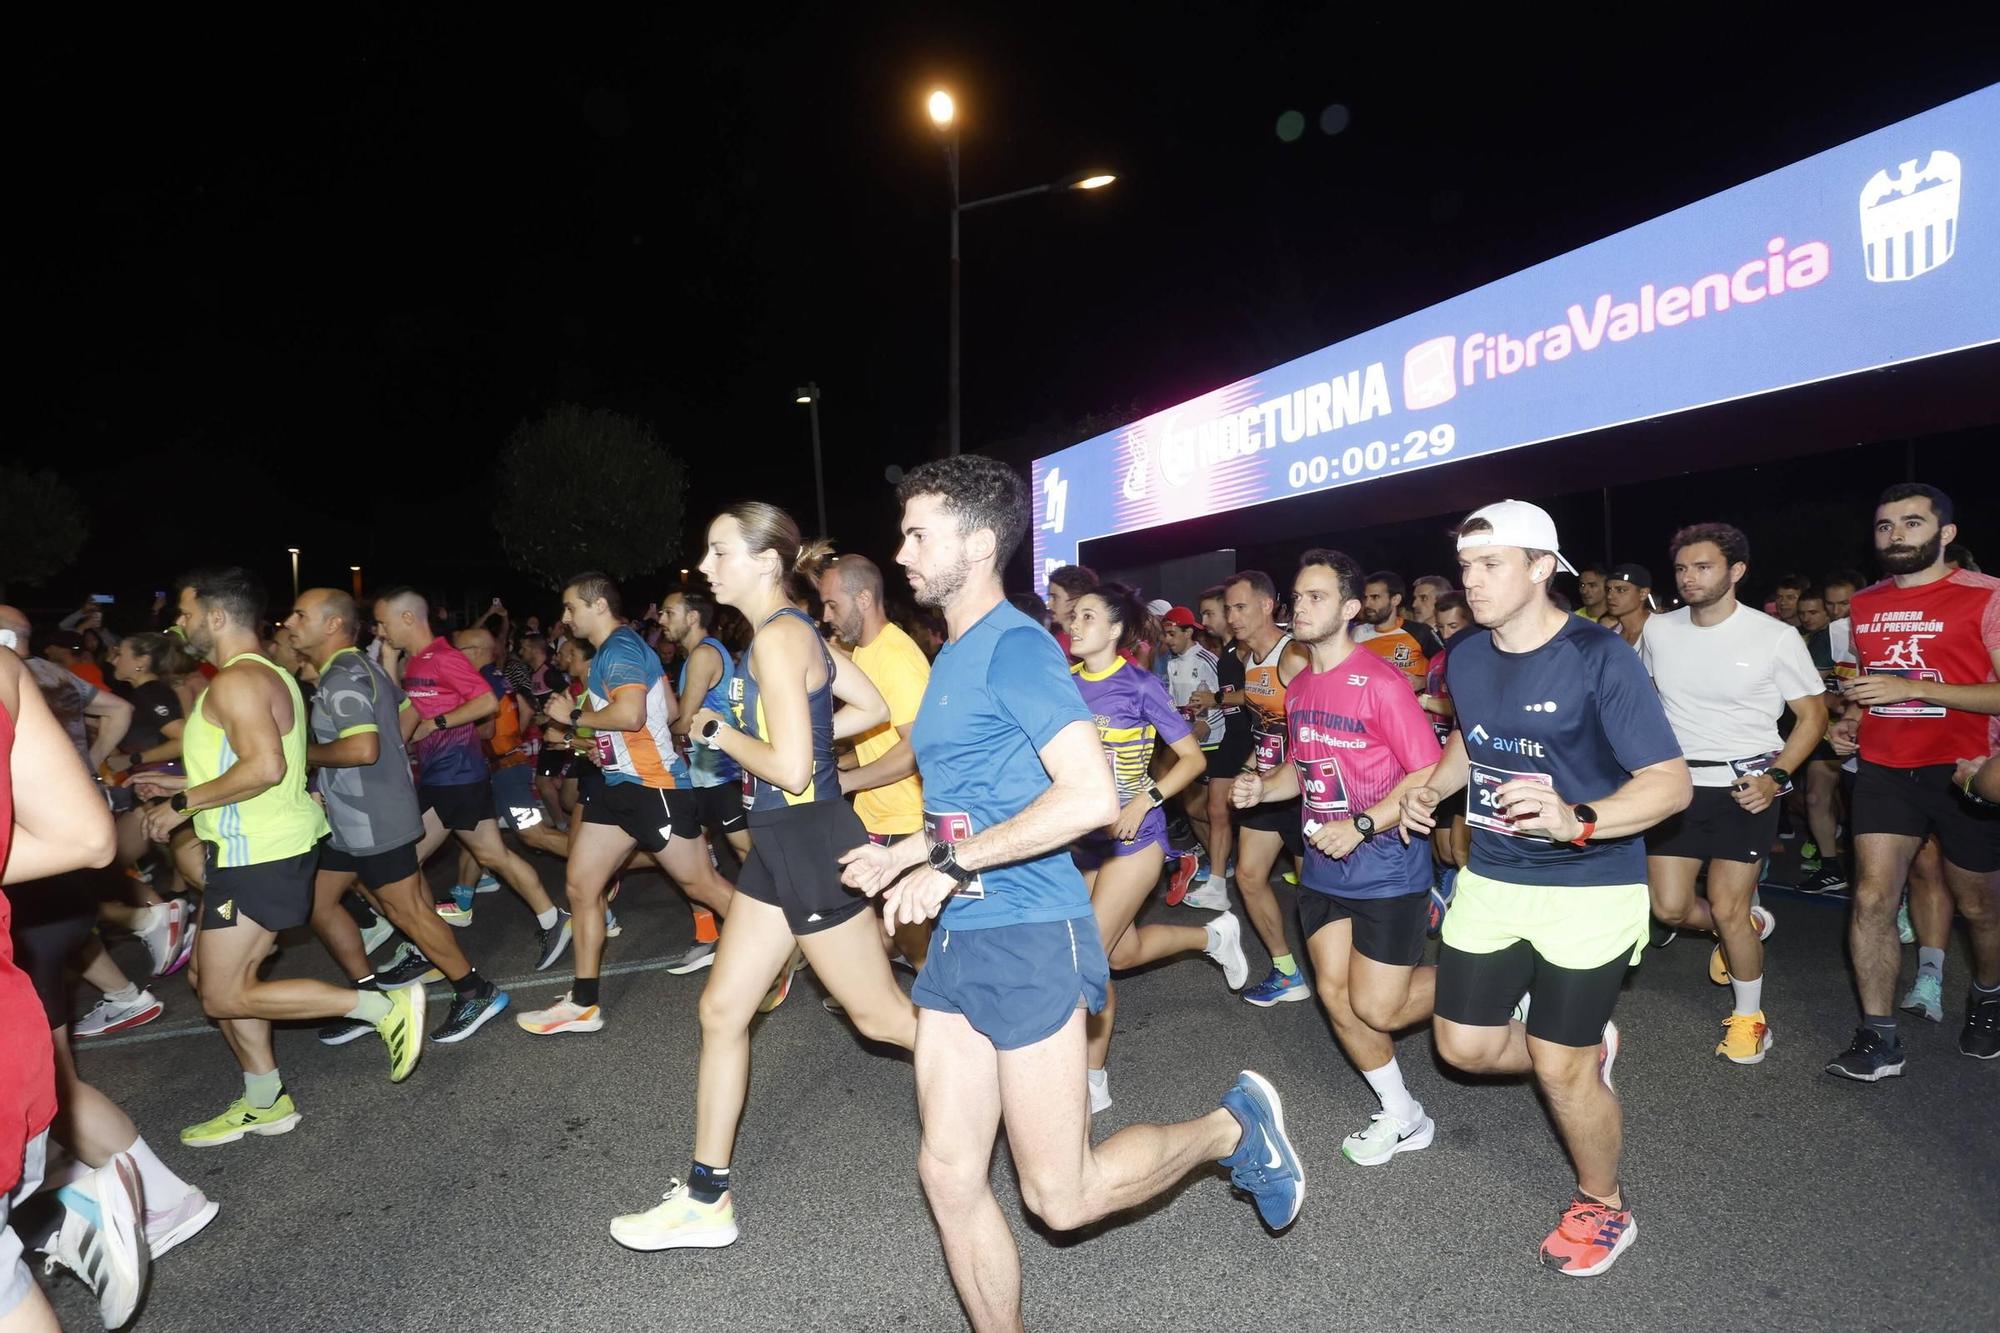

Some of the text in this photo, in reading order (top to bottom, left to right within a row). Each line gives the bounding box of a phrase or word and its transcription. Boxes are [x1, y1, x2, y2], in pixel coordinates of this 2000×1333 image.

[1462, 236, 1831, 386] fibraValencia
[1200, 362, 1391, 468] NOCTURNA
[1288, 423, 1455, 489] 00:00:29
[1870, 623, 1881, 633] LA
[1883, 619, 1944, 633] PREVENCIÓN
[1881, 611, 1923, 622] CARRERA
[1493, 737, 1545, 758] avifit
